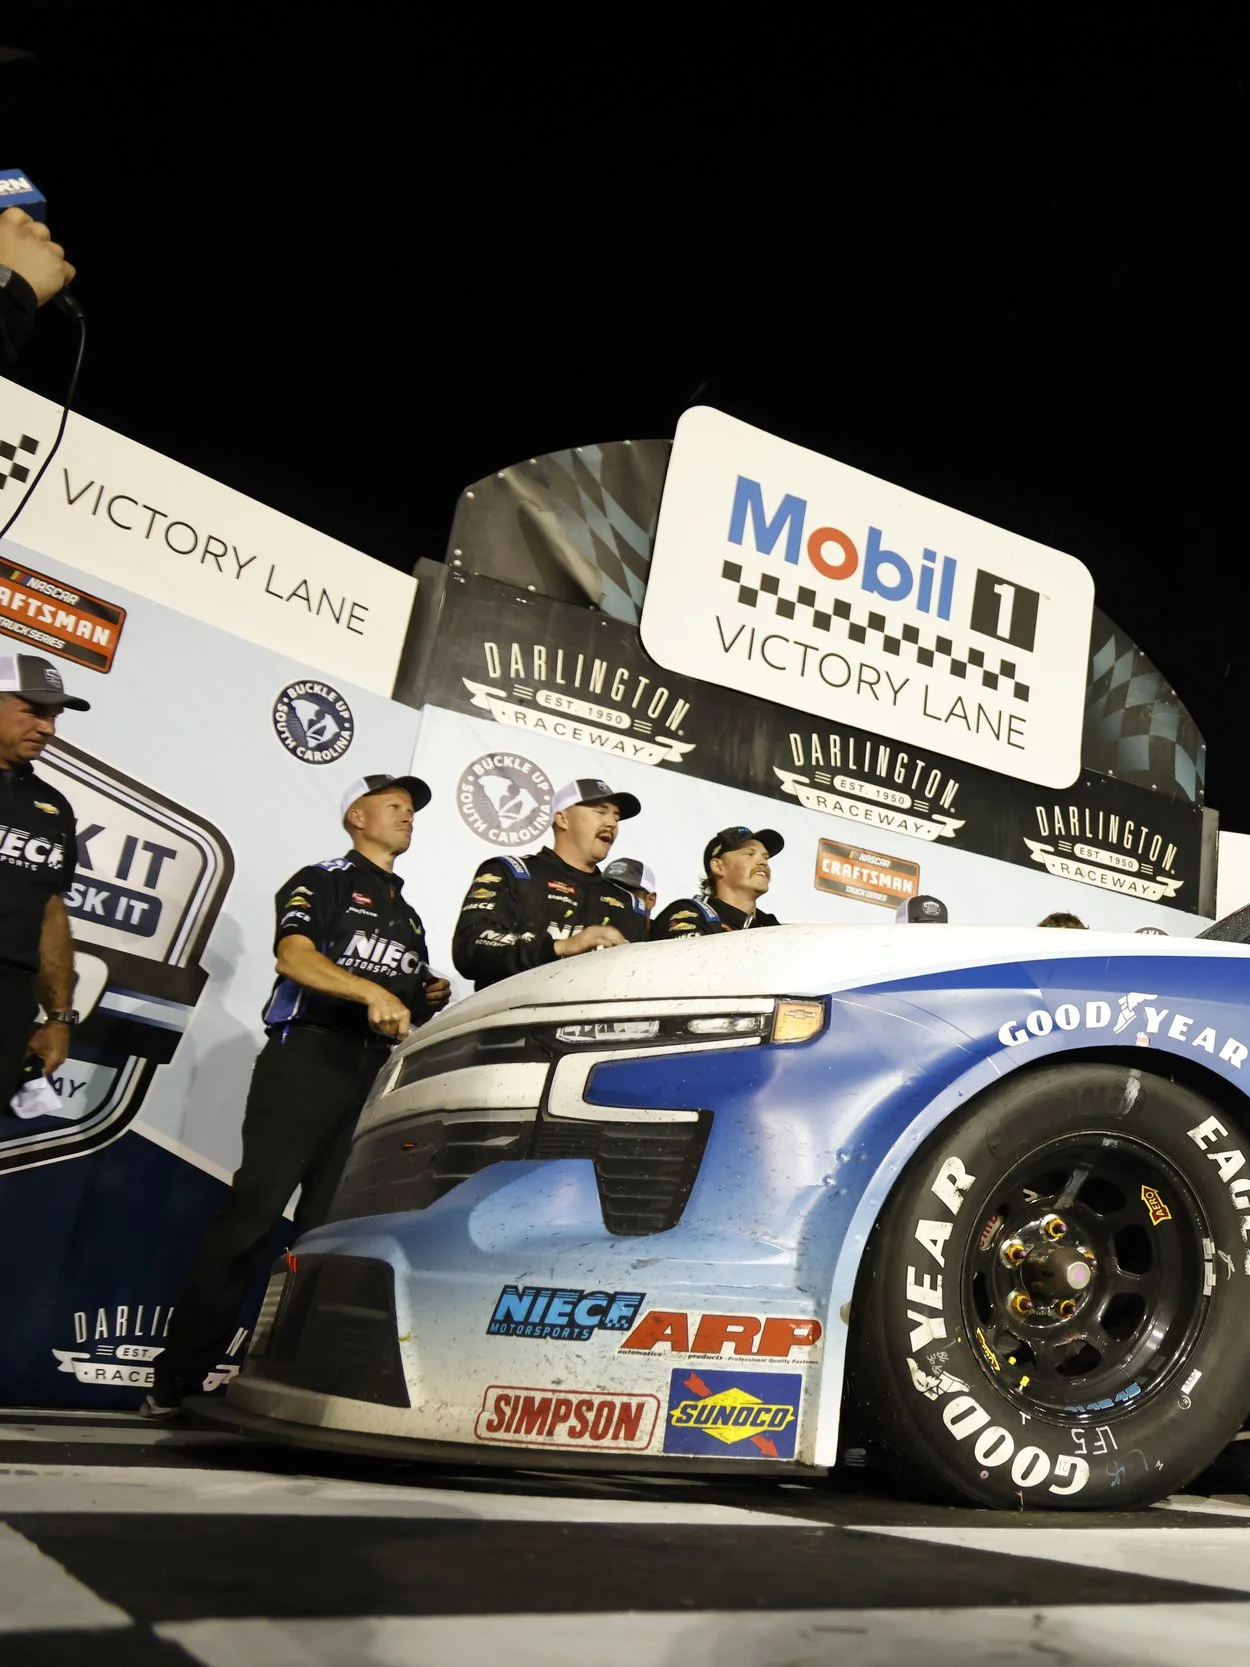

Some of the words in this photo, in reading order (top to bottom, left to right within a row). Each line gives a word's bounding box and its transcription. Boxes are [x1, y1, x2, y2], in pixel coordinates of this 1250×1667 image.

[63, 468, 257, 580] VICTORY
[265, 564, 370, 635] LANE
[727, 475, 957, 621] Mobil
[26, 576, 80, 605] NASCAR
[286, 682, 338, 702] BUCKLE
[335, 700, 351, 719] UP
[484, 641, 690, 732] DARLINGTON
[716, 615, 910, 706] VICTORY
[922, 684, 1027, 750] LANE
[544, 694, 578, 714] EST.
[587, 705, 623, 726] 1950
[275, 703, 297, 748] SOUTH
[296, 730, 352, 761] CAROLINA
[514, 711, 645, 757] RACEWAY
[472, 756, 532, 775] BUCKLE
[531, 771, 550, 791] UP
[789, 733, 960, 810] DARLINGTON
[839, 780, 868, 795] EST.
[875, 788, 906, 805] 1950
[460, 785, 485, 833] SOUTH
[488, 804, 551, 845] CAROLINA
[816, 795, 926, 833] RACEWAY
[1036, 806, 1177, 872] DARLINGTON
[1079, 847, 1102, 861] EST.
[1108, 855, 1135, 869] 1950
[115, 834, 177, 890] IT
[821, 858, 913, 894] CRAFTSMAN
[859, 853, 891, 869] NASCAR
[1061, 863, 1151, 895] RACEWAY
[115, 896, 149, 926] IT
[998, 992, 1249, 1069] GOODYEAR
[1145, 1191, 1165, 1217] AERO
[493, 1287, 643, 1330] NIECE
[490, 1322, 592, 1340] MOTORSPORTS
[620, 1310, 822, 1358] ARP
[617, 1349, 663, 1358] automotive
[687, 1353, 724, 1361] products
[486, 1393, 646, 1442] SIMPSON
[675, 1402, 791, 1429] SUNOCO
